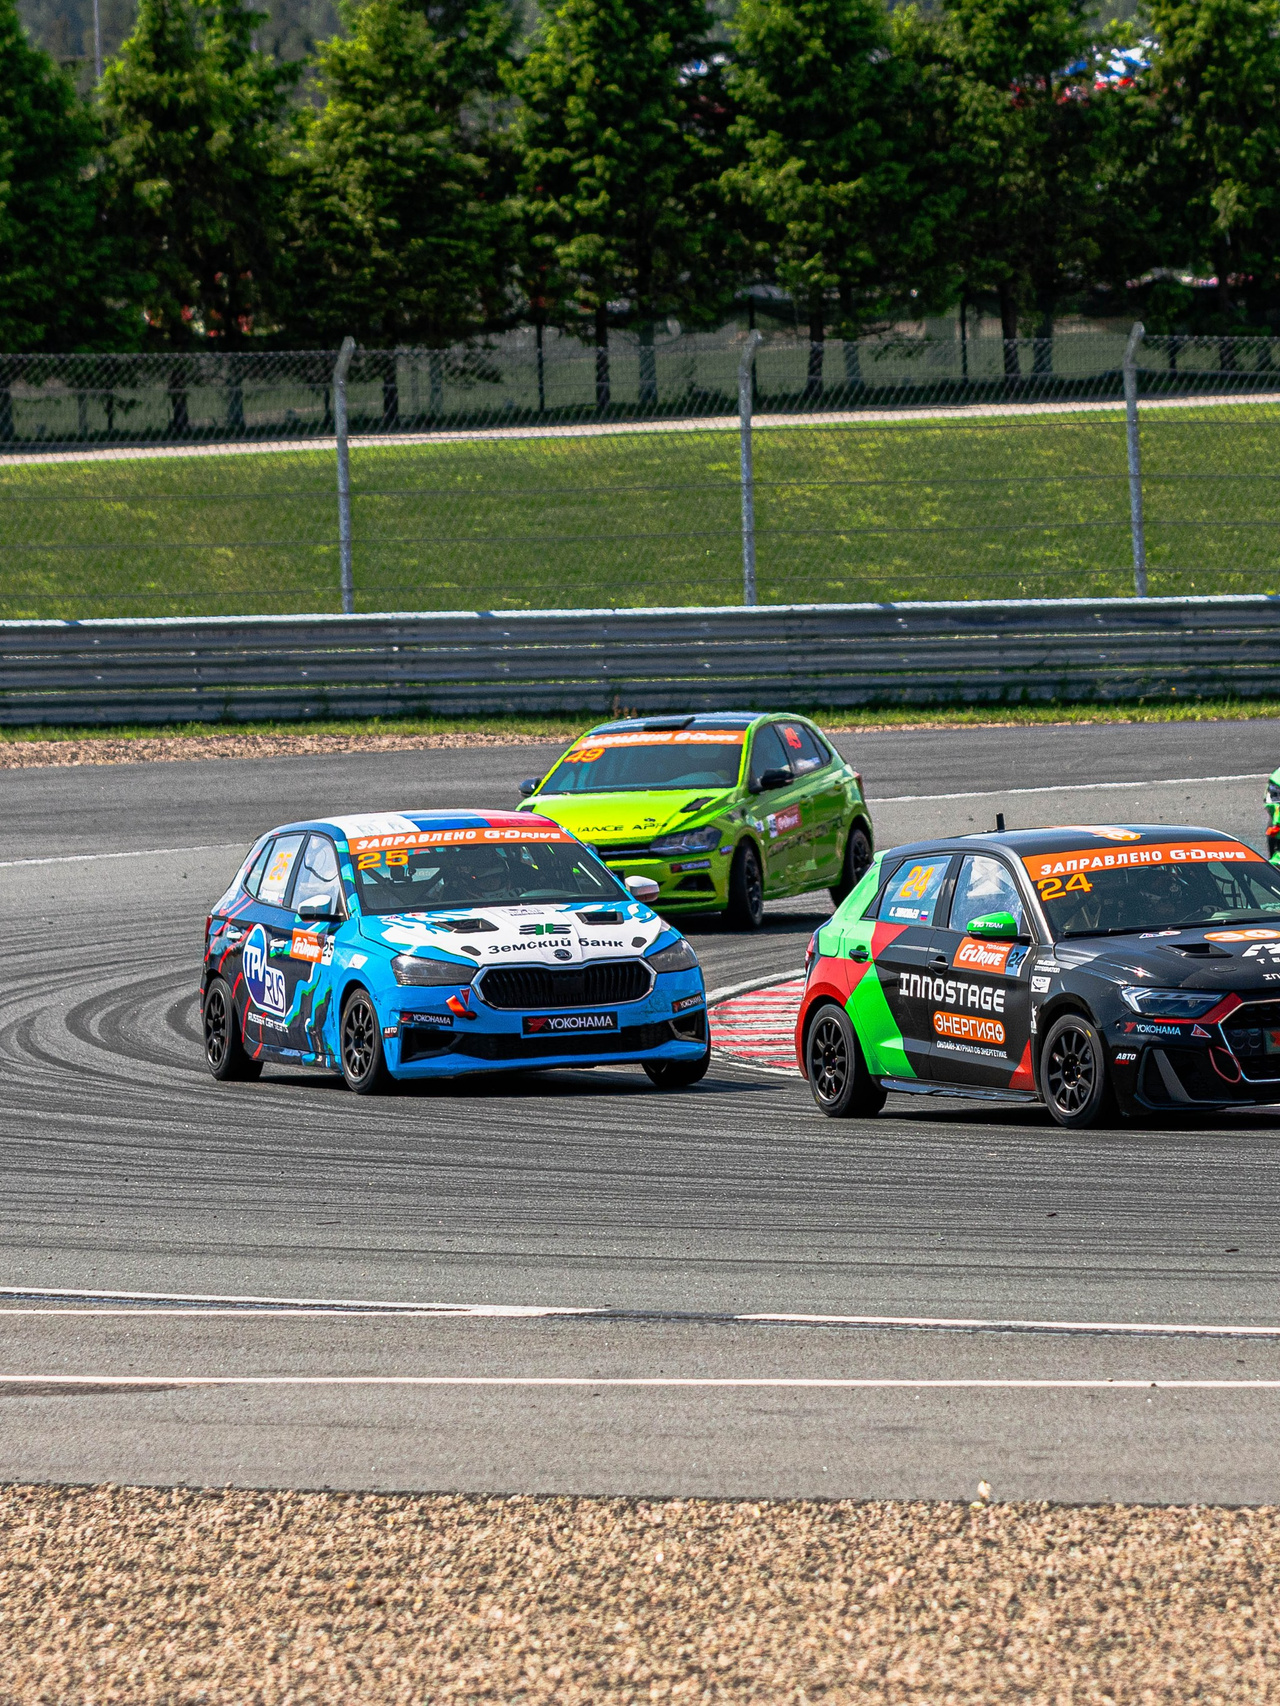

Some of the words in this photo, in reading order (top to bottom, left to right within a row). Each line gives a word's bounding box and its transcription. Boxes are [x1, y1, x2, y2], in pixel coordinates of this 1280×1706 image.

[564, 748, 605, 763] 49
[356, 830, 476, 850] ЗАПРАВЛЕНО
[269, 852, 292, 881] 25
[357, 850, 409, 870] 25
[1040, 851, 1162, 875] ЗАПРАВЛЕНО
[900, 865, 935, 899] 24
[1037, 873, 1093, 901] 24
[323, 942, 334, 957] 25
[488, 937, 572, 954] Земский
[1006, 951, 1026, 969] 24
[265, 971, 285, 1006] RUS
[899, 972, 1006, 1013] INNOSTAGE
[412, 1013, 451, 1024] YOKOHAMA
[549, 1015, 613, 1030] YOKOHAMA
[1136, 1024, 1181, 1035] YOKOHAMA
